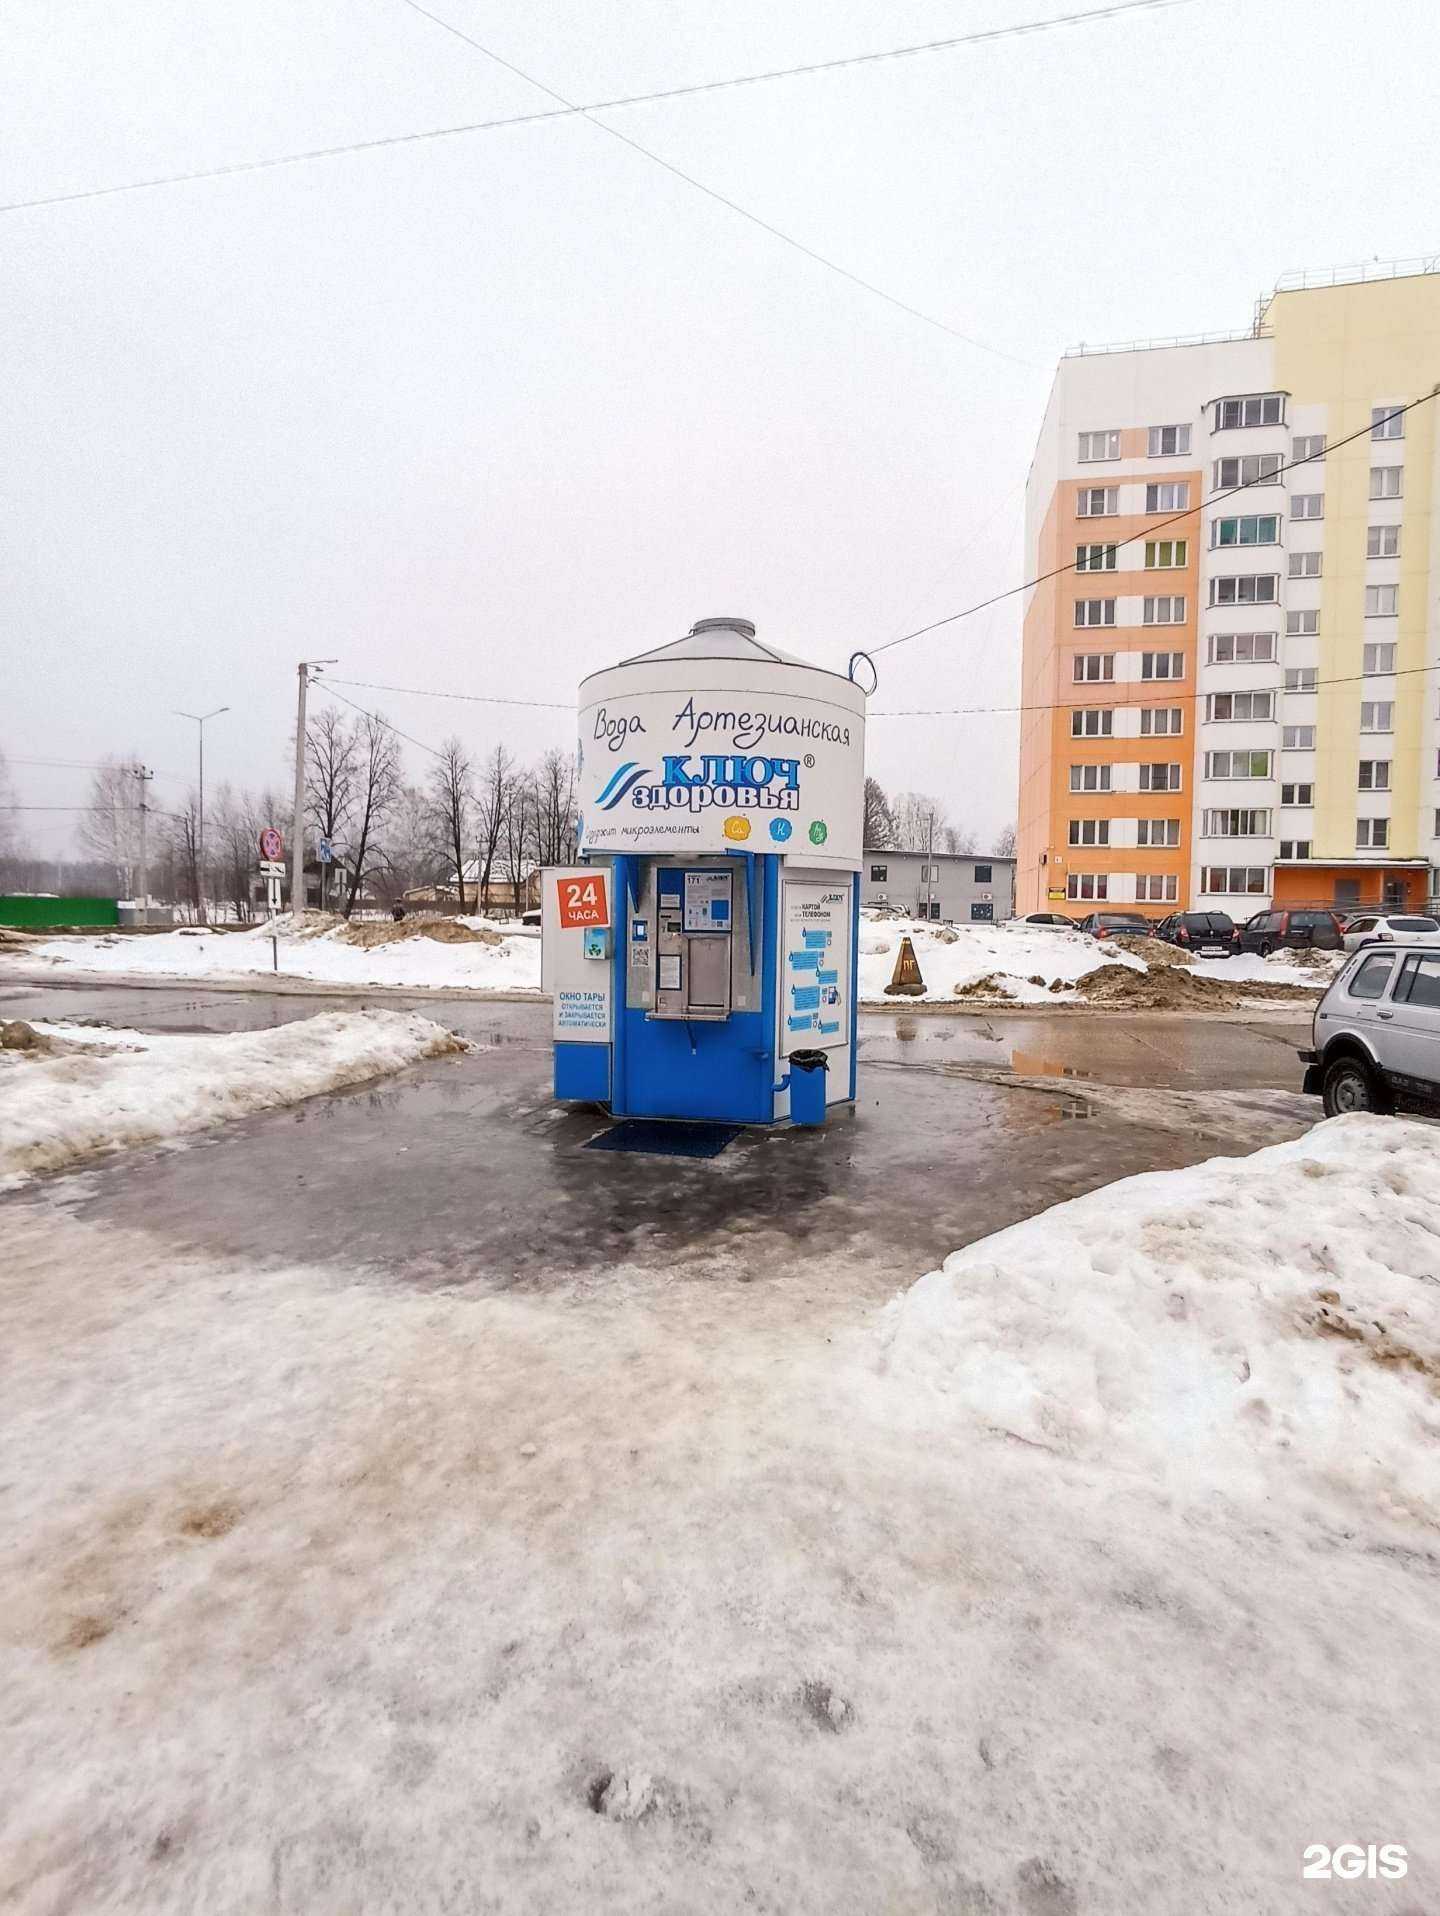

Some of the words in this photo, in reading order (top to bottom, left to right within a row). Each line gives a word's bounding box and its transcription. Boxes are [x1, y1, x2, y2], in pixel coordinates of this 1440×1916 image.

[594, 708, 647, 751] Вода
[672, 697, 850, 750] Артезианская
[663, 755, 800, 789] КЛЮЧ
[632, 785, 799, 813] здоровья
[621, 824, 700, 842] микроэлементы
[566, 882, 598, 908] 24
[568, 909, 600, 921] ЧАСА
[559, 991, 581, 1001] ОКНО
[583, 992, 606, 1002] ТАРЫ
